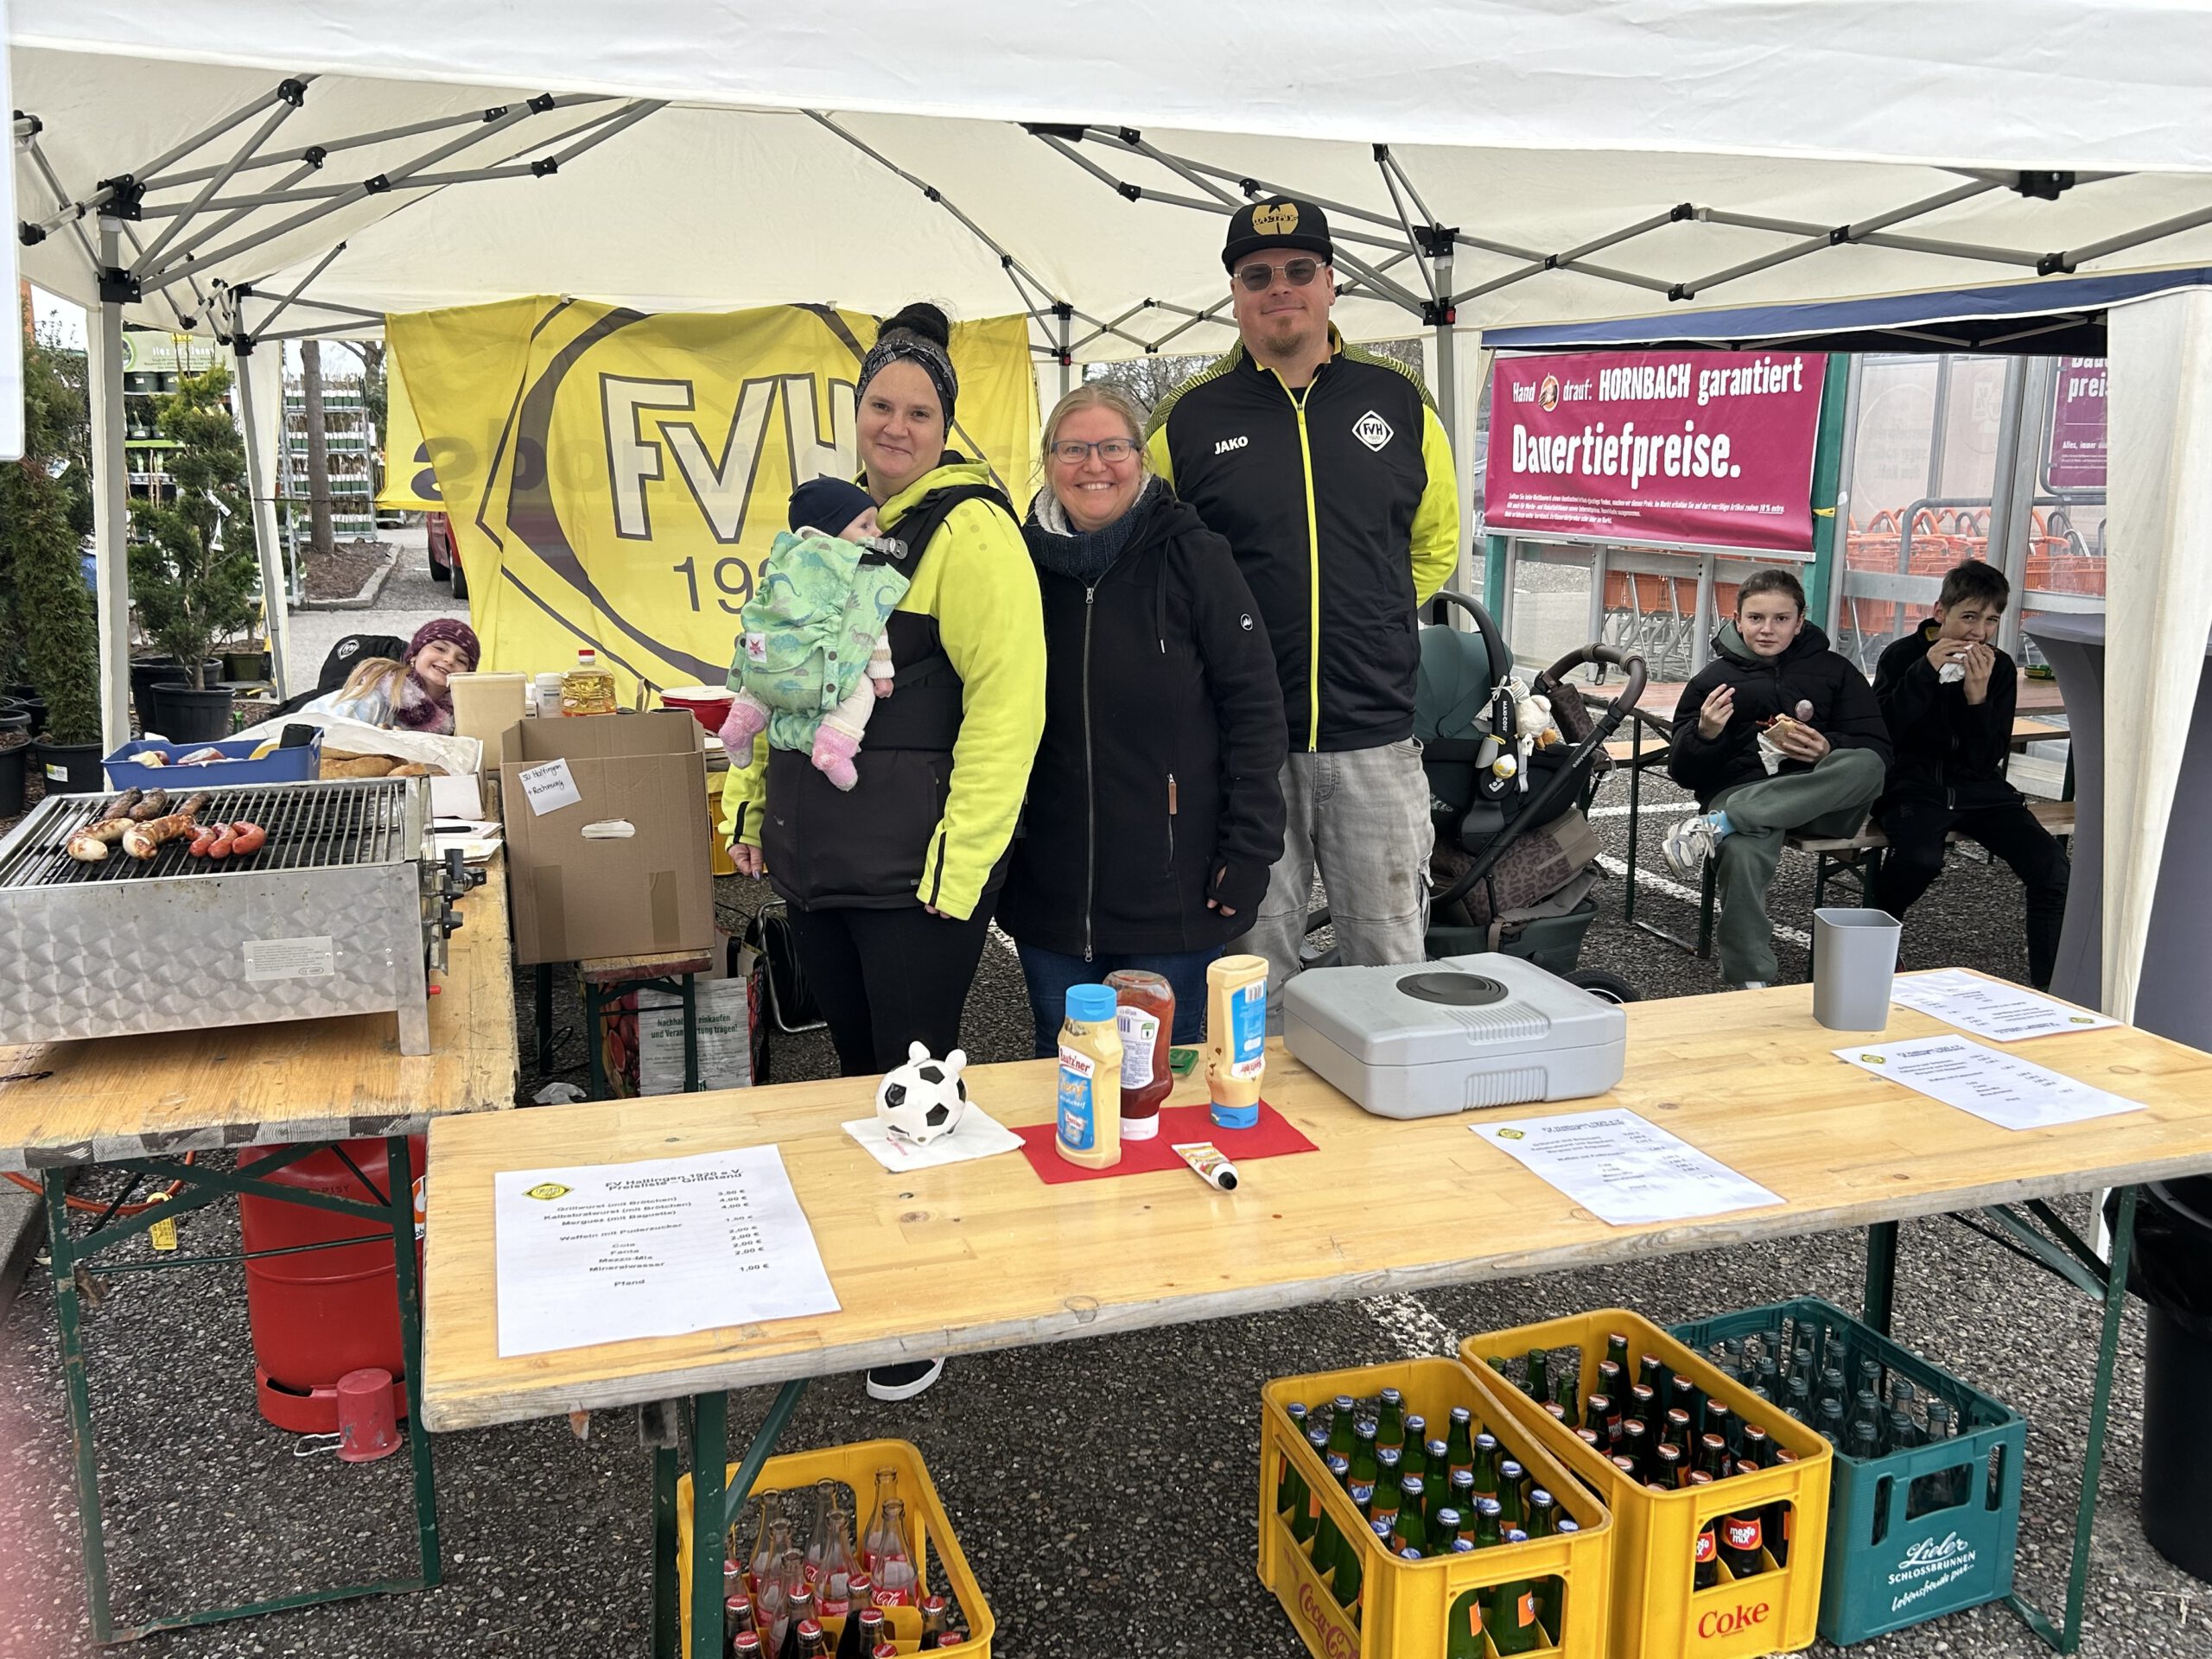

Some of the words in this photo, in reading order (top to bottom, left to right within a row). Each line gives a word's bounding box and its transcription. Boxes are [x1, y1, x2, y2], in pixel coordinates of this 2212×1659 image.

[1512, 381, 1536, 404] Hand
[1563, 380, 1592, 403] drauf:
[1599, 363, 1692, 403] HORNBACH
[1698, 356, 1803, 406] garantiert
[2068, 372, 2107, 404] prei
[1214, 435, 1249, 454] JAKO
[1363, 423, 1383, 435] FVH
[1512, 420, 1741, 490] Dauertiefpreise.
[673, 556, 770, 614] 19
[1888, 1550, 1976, 1585] SCHLOSSBRUNNEN
[1699, 1602, 1770, 1639] Coke
